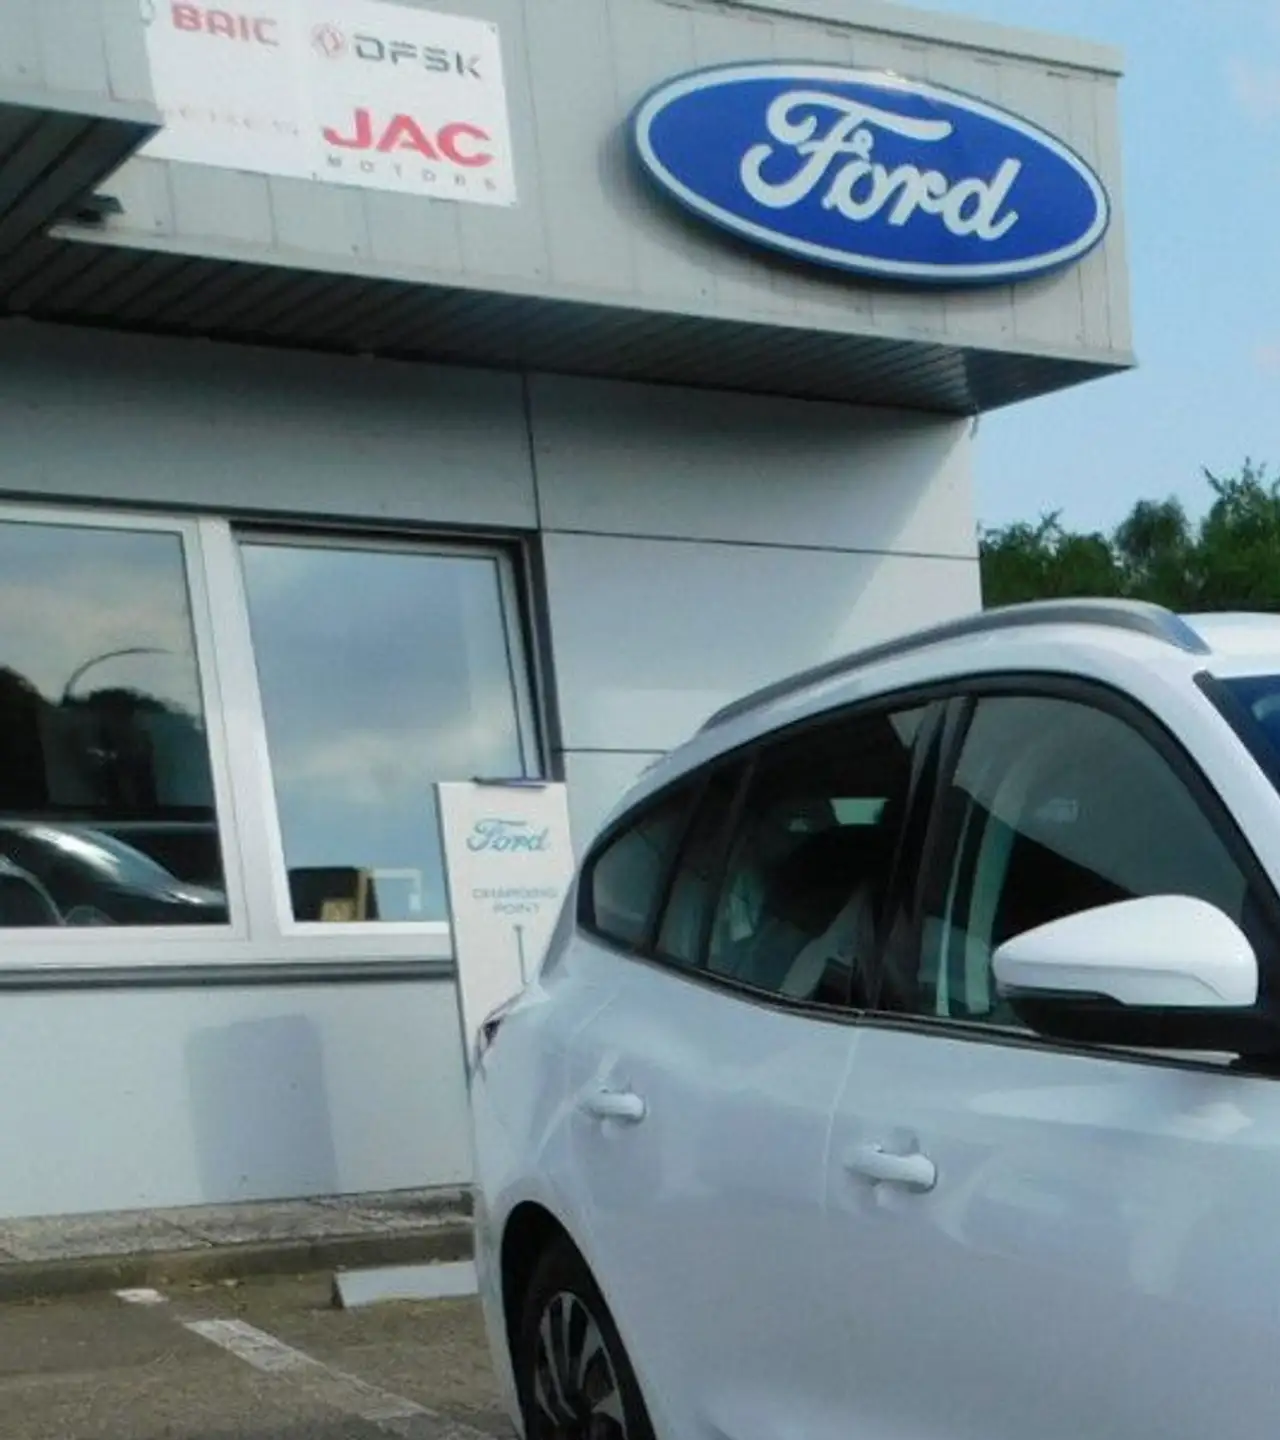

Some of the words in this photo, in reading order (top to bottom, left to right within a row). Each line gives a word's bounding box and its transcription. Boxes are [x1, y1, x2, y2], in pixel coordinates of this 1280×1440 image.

[354, 32, 483, 80] DFSK
[322, 107, 495, 168] JAC
[740, 90, 1022, 241] Ford
[466, 818, 551, 852] Ford
